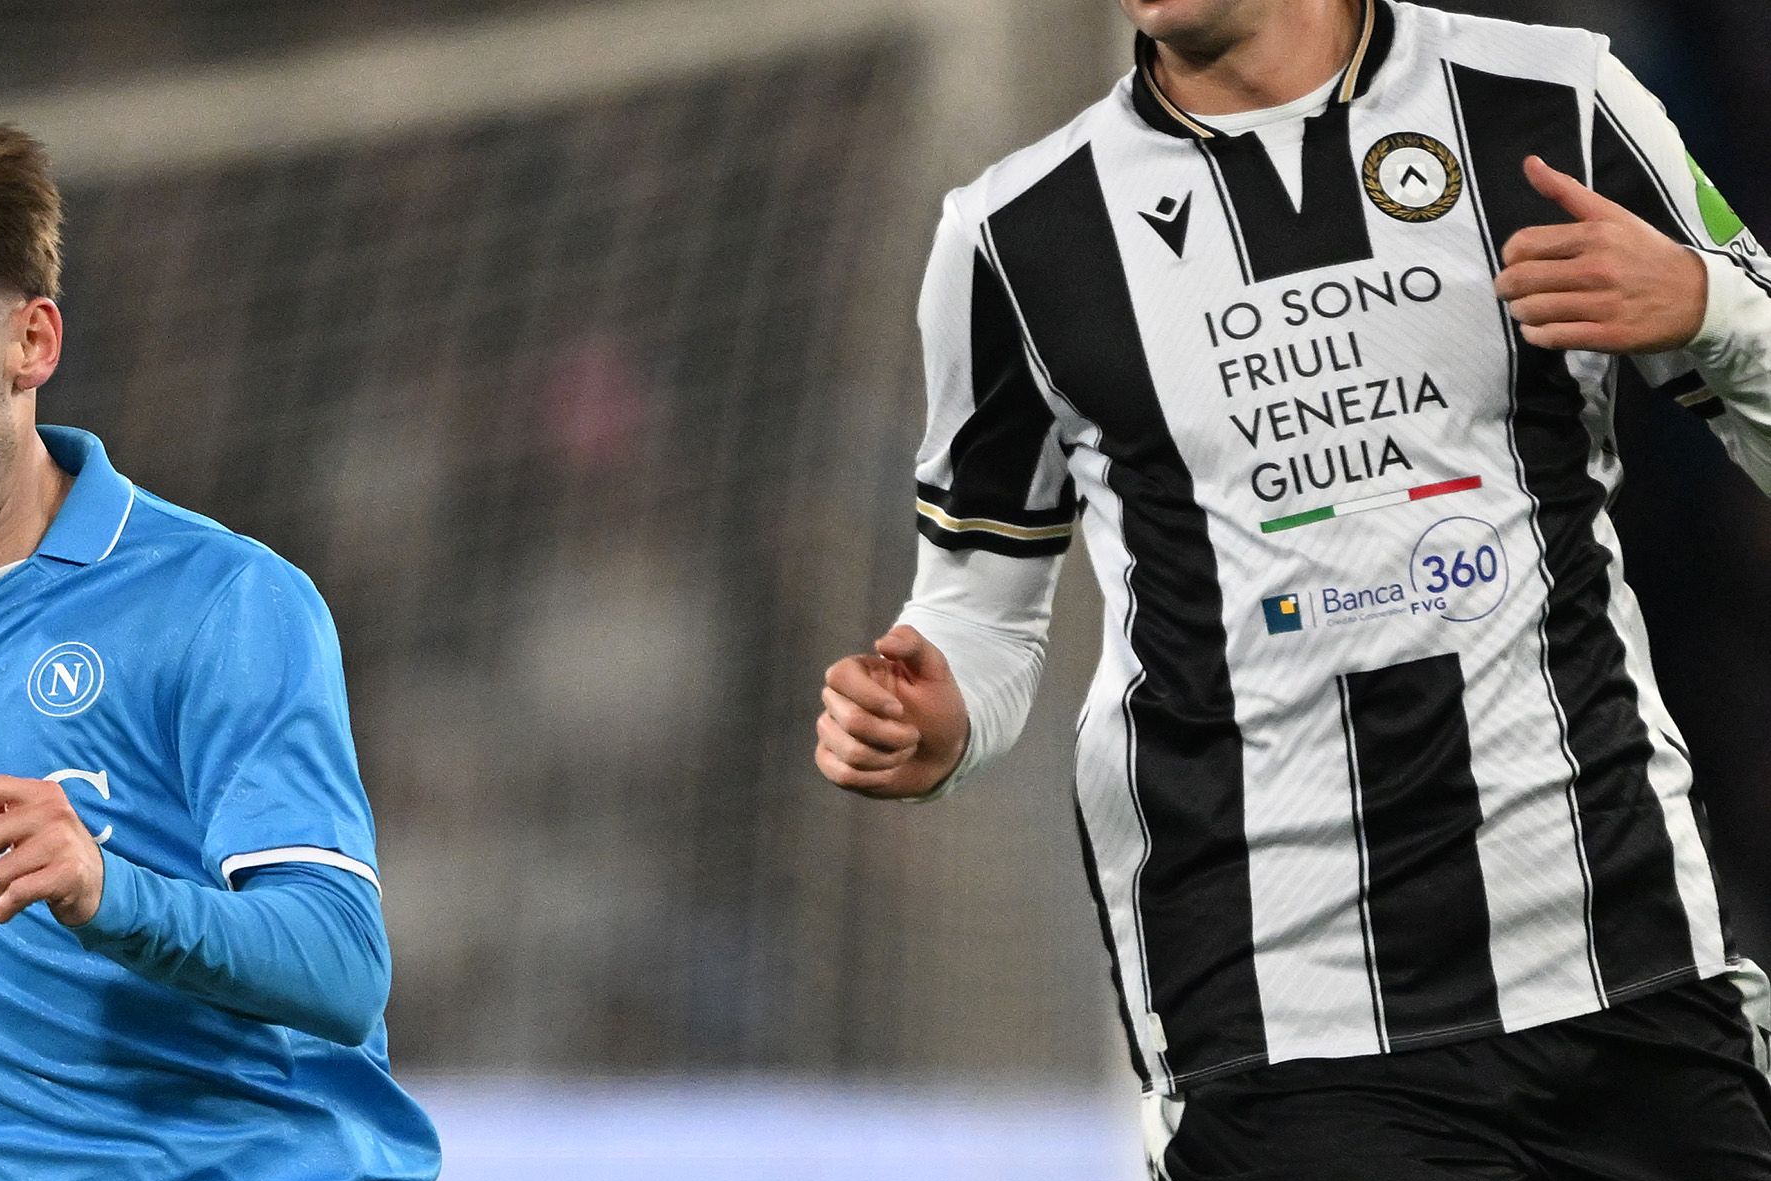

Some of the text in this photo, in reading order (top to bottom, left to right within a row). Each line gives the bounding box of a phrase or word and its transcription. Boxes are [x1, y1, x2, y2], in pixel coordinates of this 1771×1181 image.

[1204, 265, 1442, 347] IO SONO
[1218, 331, 1364, 398] FRIULI
[1229, 372, 1449, 450] VENEZIA
[1250, 435, 1414, 503] GIULIA
[1322, 544, 1498, 614] Banca 360
[1410, 596, 1447, 615] FVG
[48, 662, 83, 697] N
